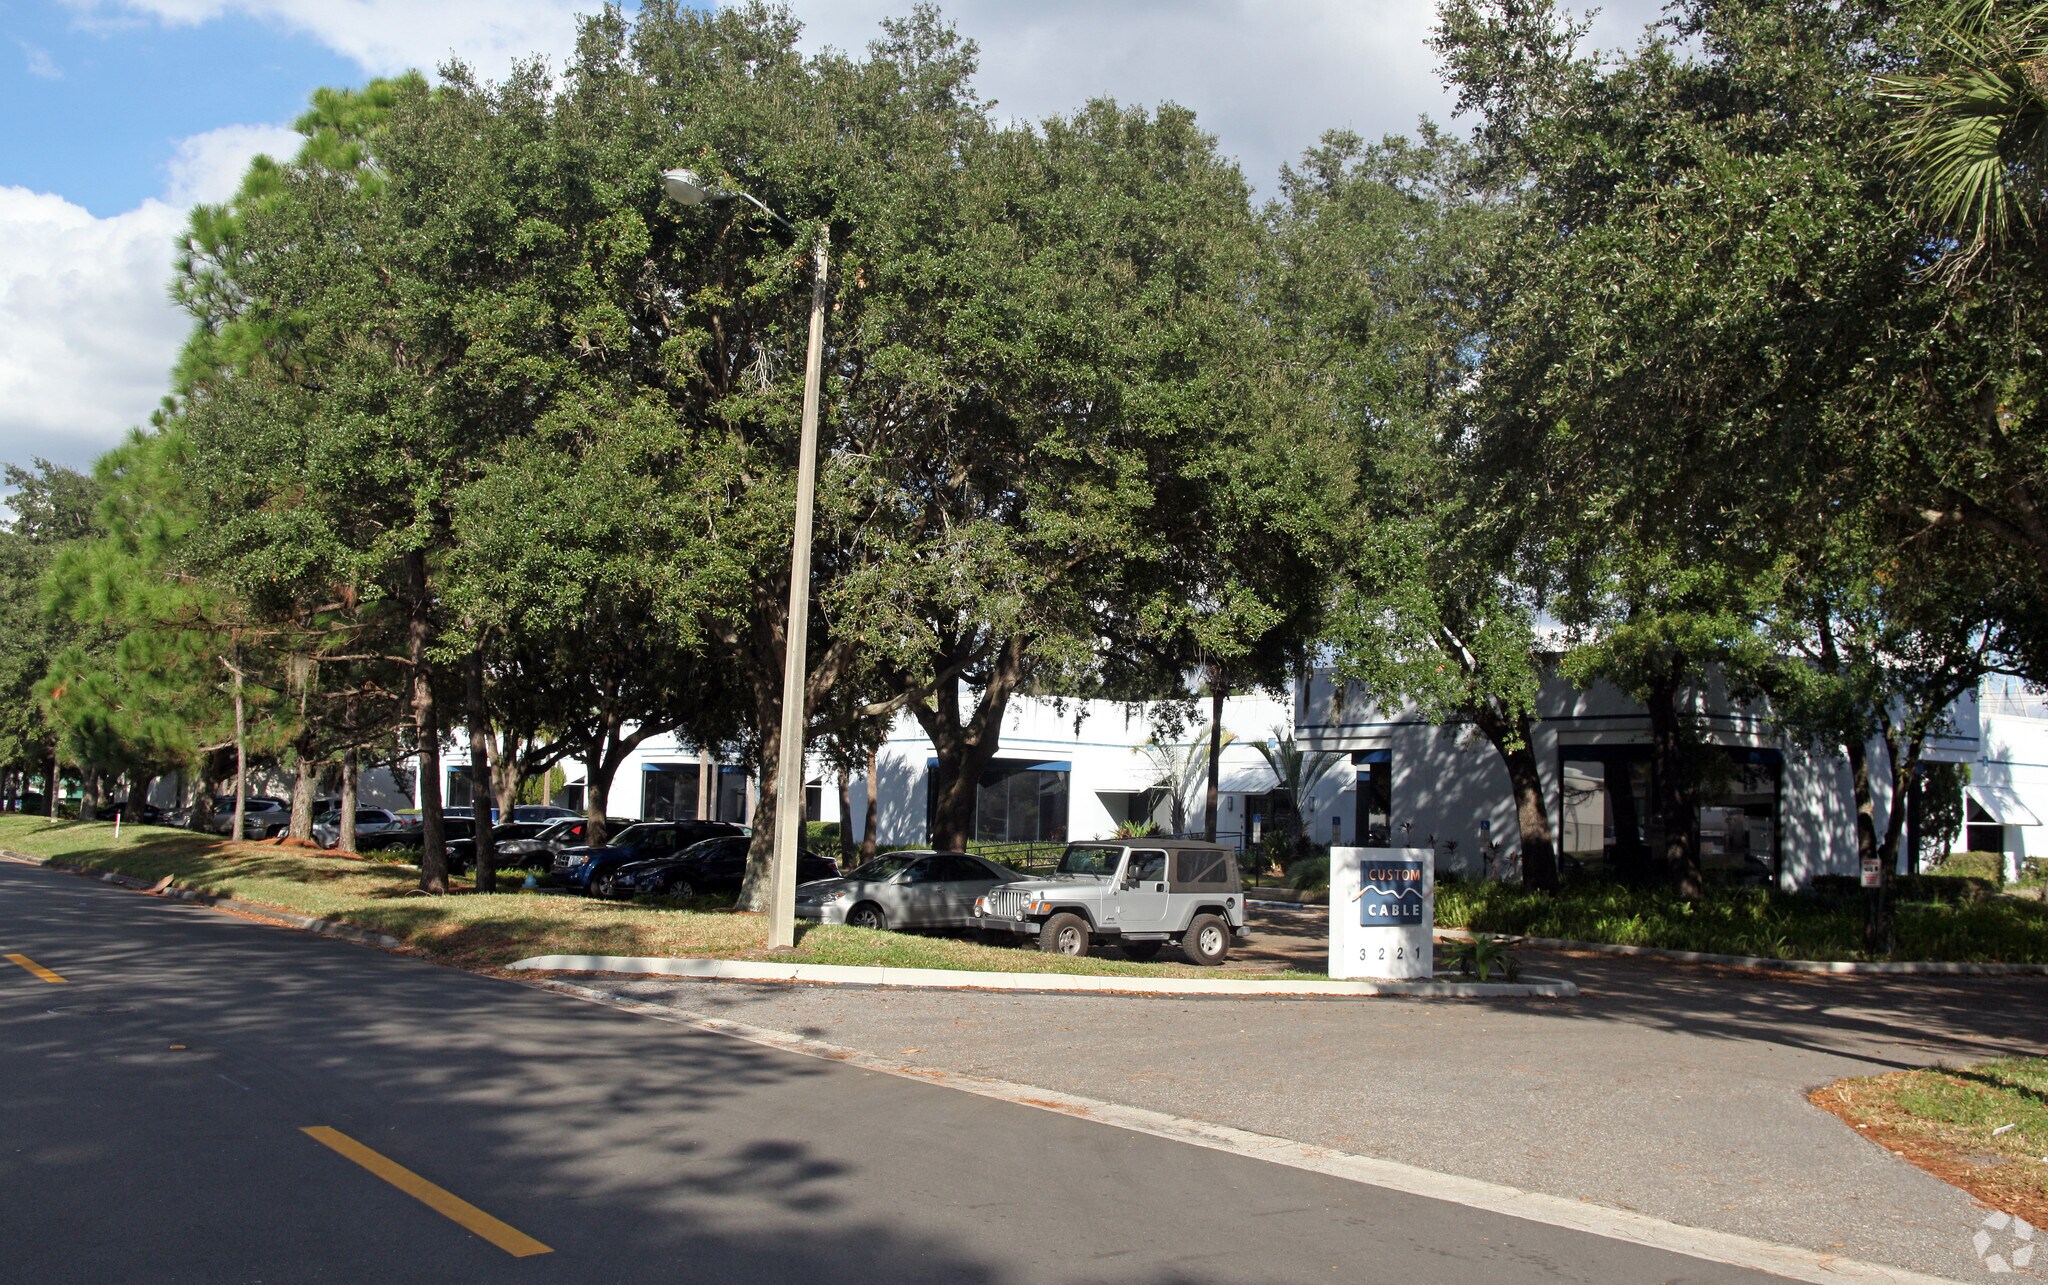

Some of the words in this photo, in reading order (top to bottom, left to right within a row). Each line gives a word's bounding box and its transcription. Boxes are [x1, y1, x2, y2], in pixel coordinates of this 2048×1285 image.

[1368, 869, 1421, 881] CUSTOM
[1368, 904, 1420, 916] CABLE
[1359, 946, 1420, 961] 3221
